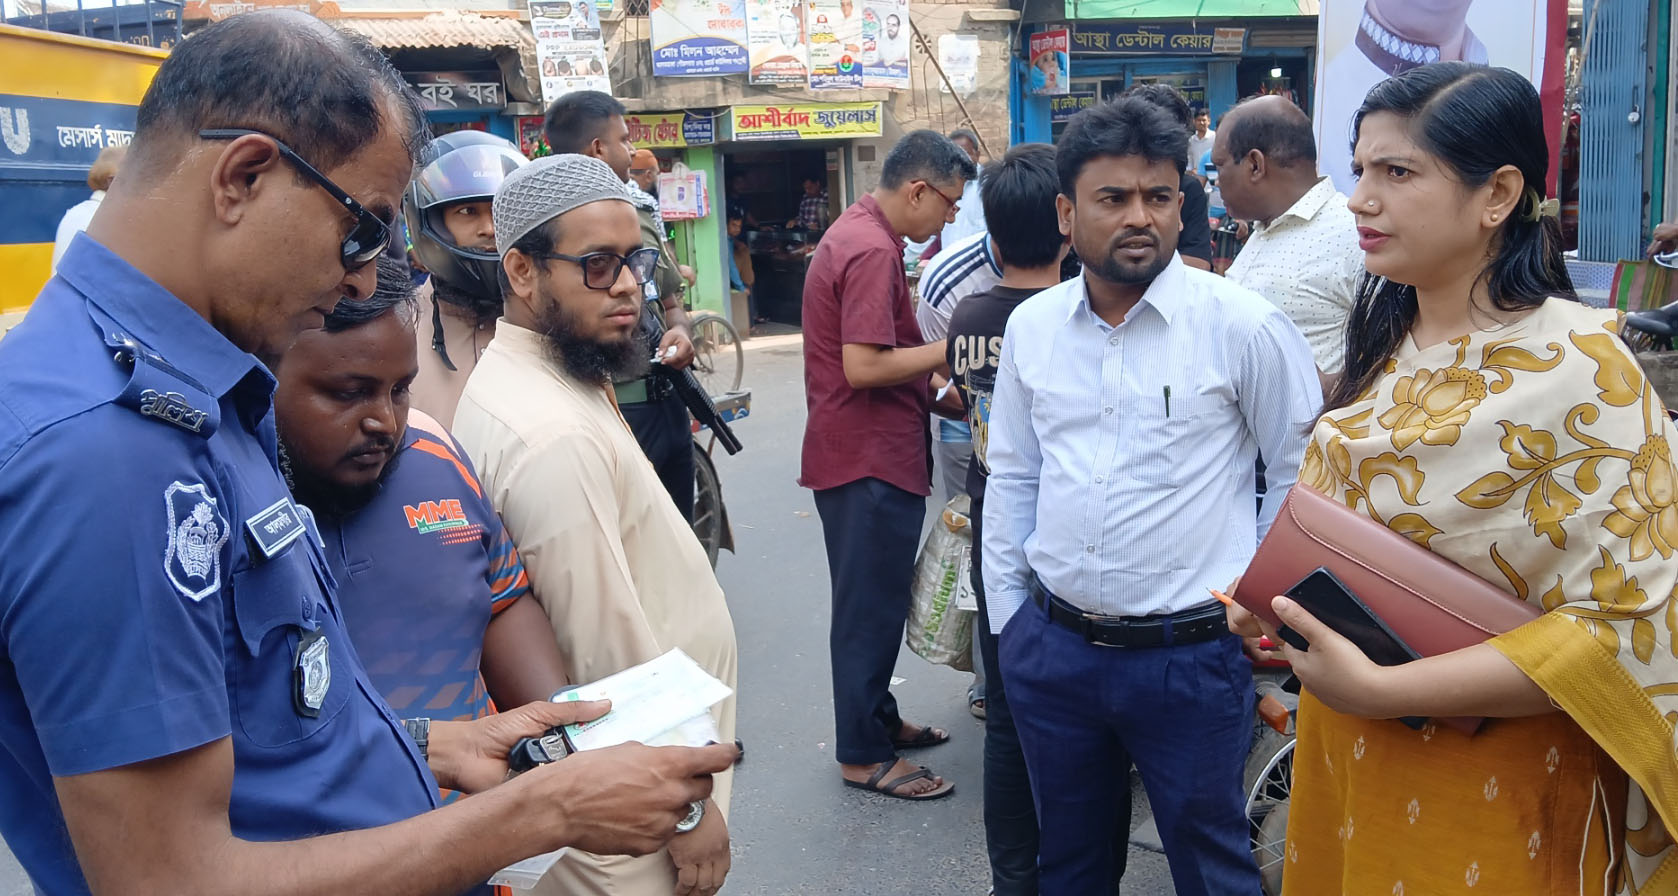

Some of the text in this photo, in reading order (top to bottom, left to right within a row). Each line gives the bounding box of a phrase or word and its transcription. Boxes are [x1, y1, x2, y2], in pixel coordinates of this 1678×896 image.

[660, 47, 679, 58] মোঃ
[680, 44, 703, 57] মিলন
[1072, 31, 1111, 51] আস্থা
[1116, 30, 1166, 49] ডেন্টাল
[1170, 34, 1214, 49] কেয়ার
[417, 75, 500, 108] বই ঘর
[736, 105, 879, 129] আশীর্বাদ জুয়েলার্স
[56, 124, 104, 149] মেসার্স
[403, 498, 467, 529] MME
